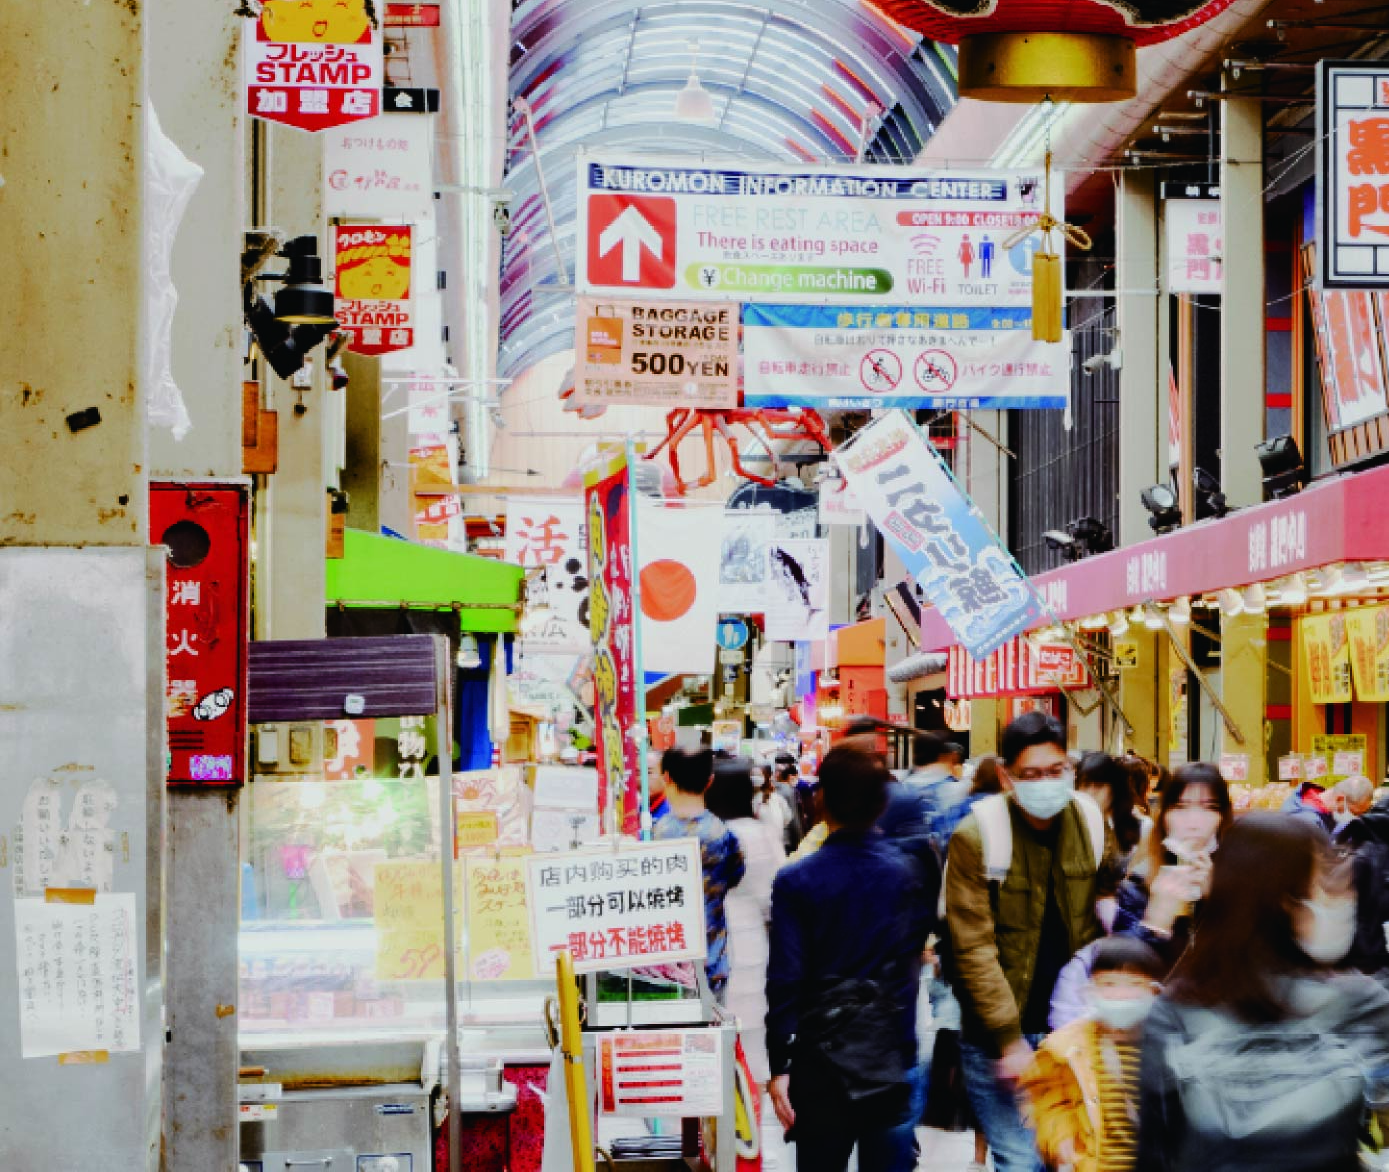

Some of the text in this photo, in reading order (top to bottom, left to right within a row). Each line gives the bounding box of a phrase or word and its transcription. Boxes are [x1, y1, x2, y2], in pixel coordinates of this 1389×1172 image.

[266, 44, 359, 62] フレッシュ
[256, 62, 372, 84] STAMP
[256, 88, 372, 115] 加盟店
[601, 165, 993, 199] KUROMON INFORMATION CENTER
[693, 205, 882, 233] FREE REST AREA
[696, 231, 879, 255] There is eating space
[907, 259, 945, 274] FREE
[722, 267, 794, 292] Change
[798, 269, 878, 291] machine
[907, 278, 945, 294] Wi-Fi
[334, 313, 410, 326] STAMP
[632, 306, 730, 324] BAGGAGE
[631, 324, 730, 341] STORAGE
[515, 515, 569, 565] 活
